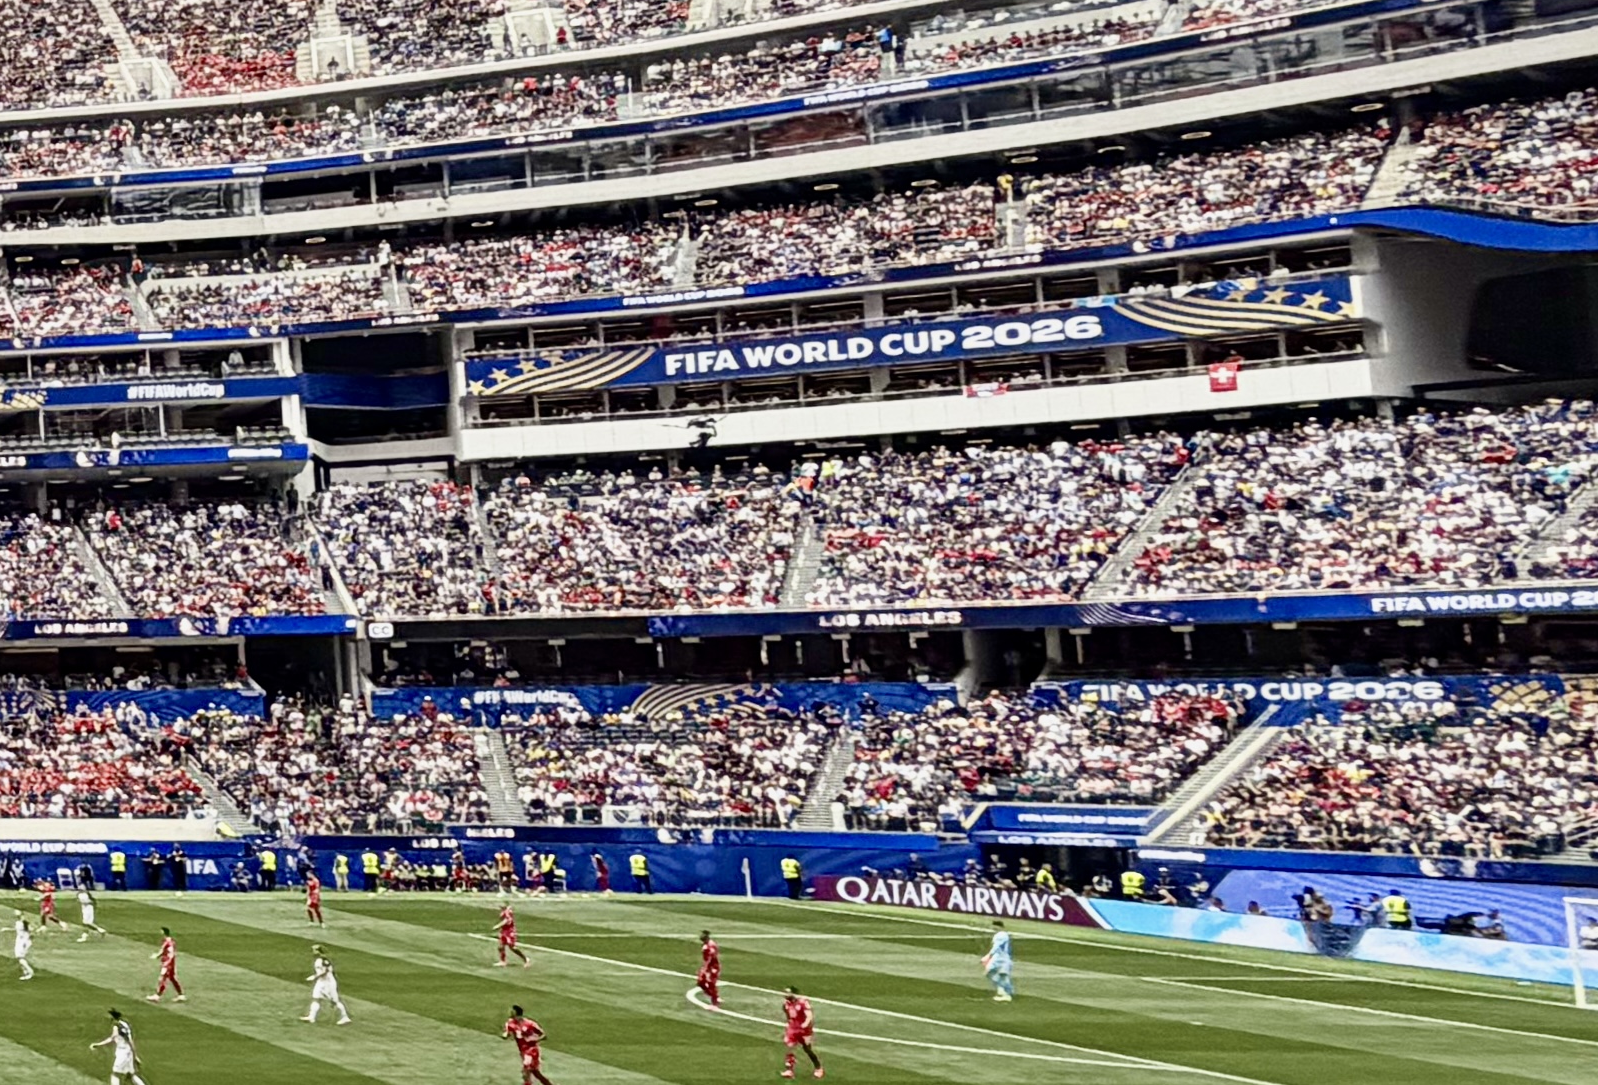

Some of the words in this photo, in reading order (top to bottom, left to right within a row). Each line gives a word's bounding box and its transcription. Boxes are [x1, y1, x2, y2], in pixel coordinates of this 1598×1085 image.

[664, 348, 741, 376] FIFA
[743, 335, 874, 368] WORLD
[879, 327, 956, 357] CUP
[960, 315, 1103, 349] 2026
[1371, 597, 1427, 613] FIFA
[1426, 593, 1518, 610] WORLD
[1519, 592, 1570, 608] CUP
[1571, 590, 1598, 606] 2
[819, 614, 861, 627] LOS
[865, 611, 963, 626] ANGELES
[1260, 682, 1324, 701] CUP
[1327, 681, 1445, 700] 2026
[186, 859, 219, 875] IFA
[836, 876, 939, 908] QATAR
[947, 886, 1065, 922] AIRWAYS
